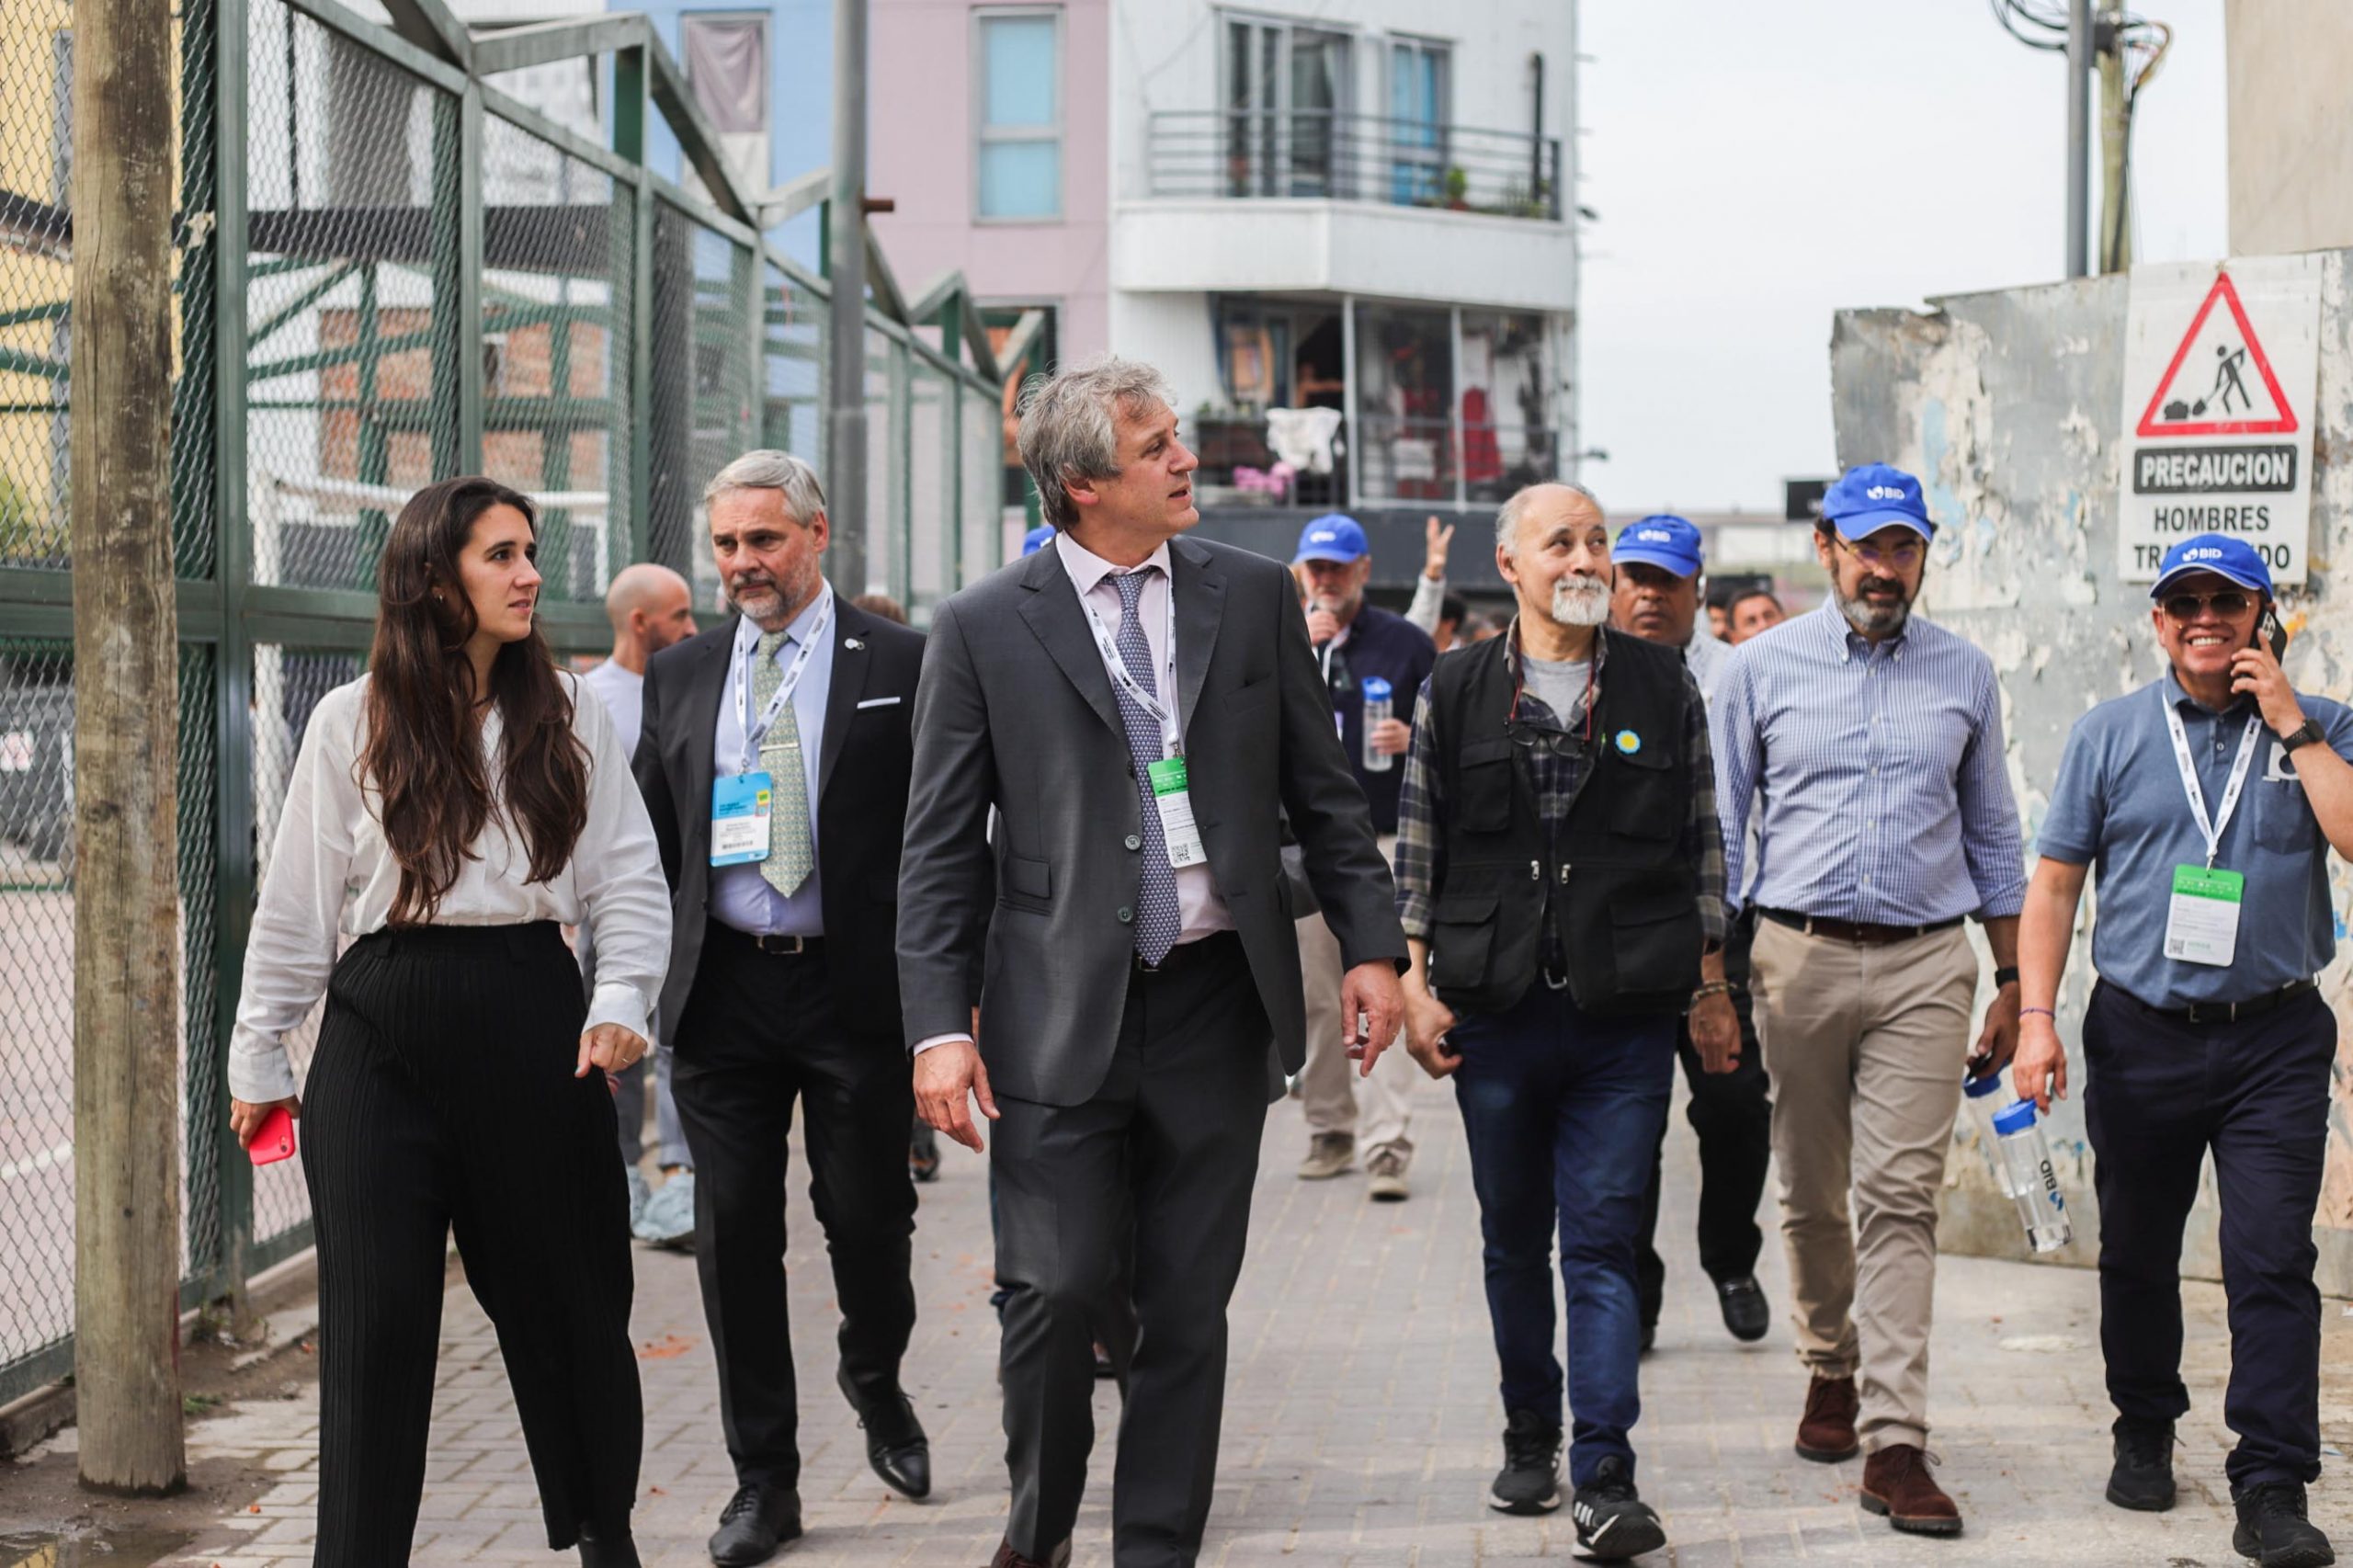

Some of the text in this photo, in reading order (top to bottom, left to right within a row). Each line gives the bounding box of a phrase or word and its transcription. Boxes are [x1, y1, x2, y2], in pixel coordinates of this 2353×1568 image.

[2141, 452, 2290, 487] PRECAUCION
[2154, 506, 2269, 531] HOMBRES
[2200, 548, 2222, 559] BID
[2040, 1160, 2057, 1190] BID
